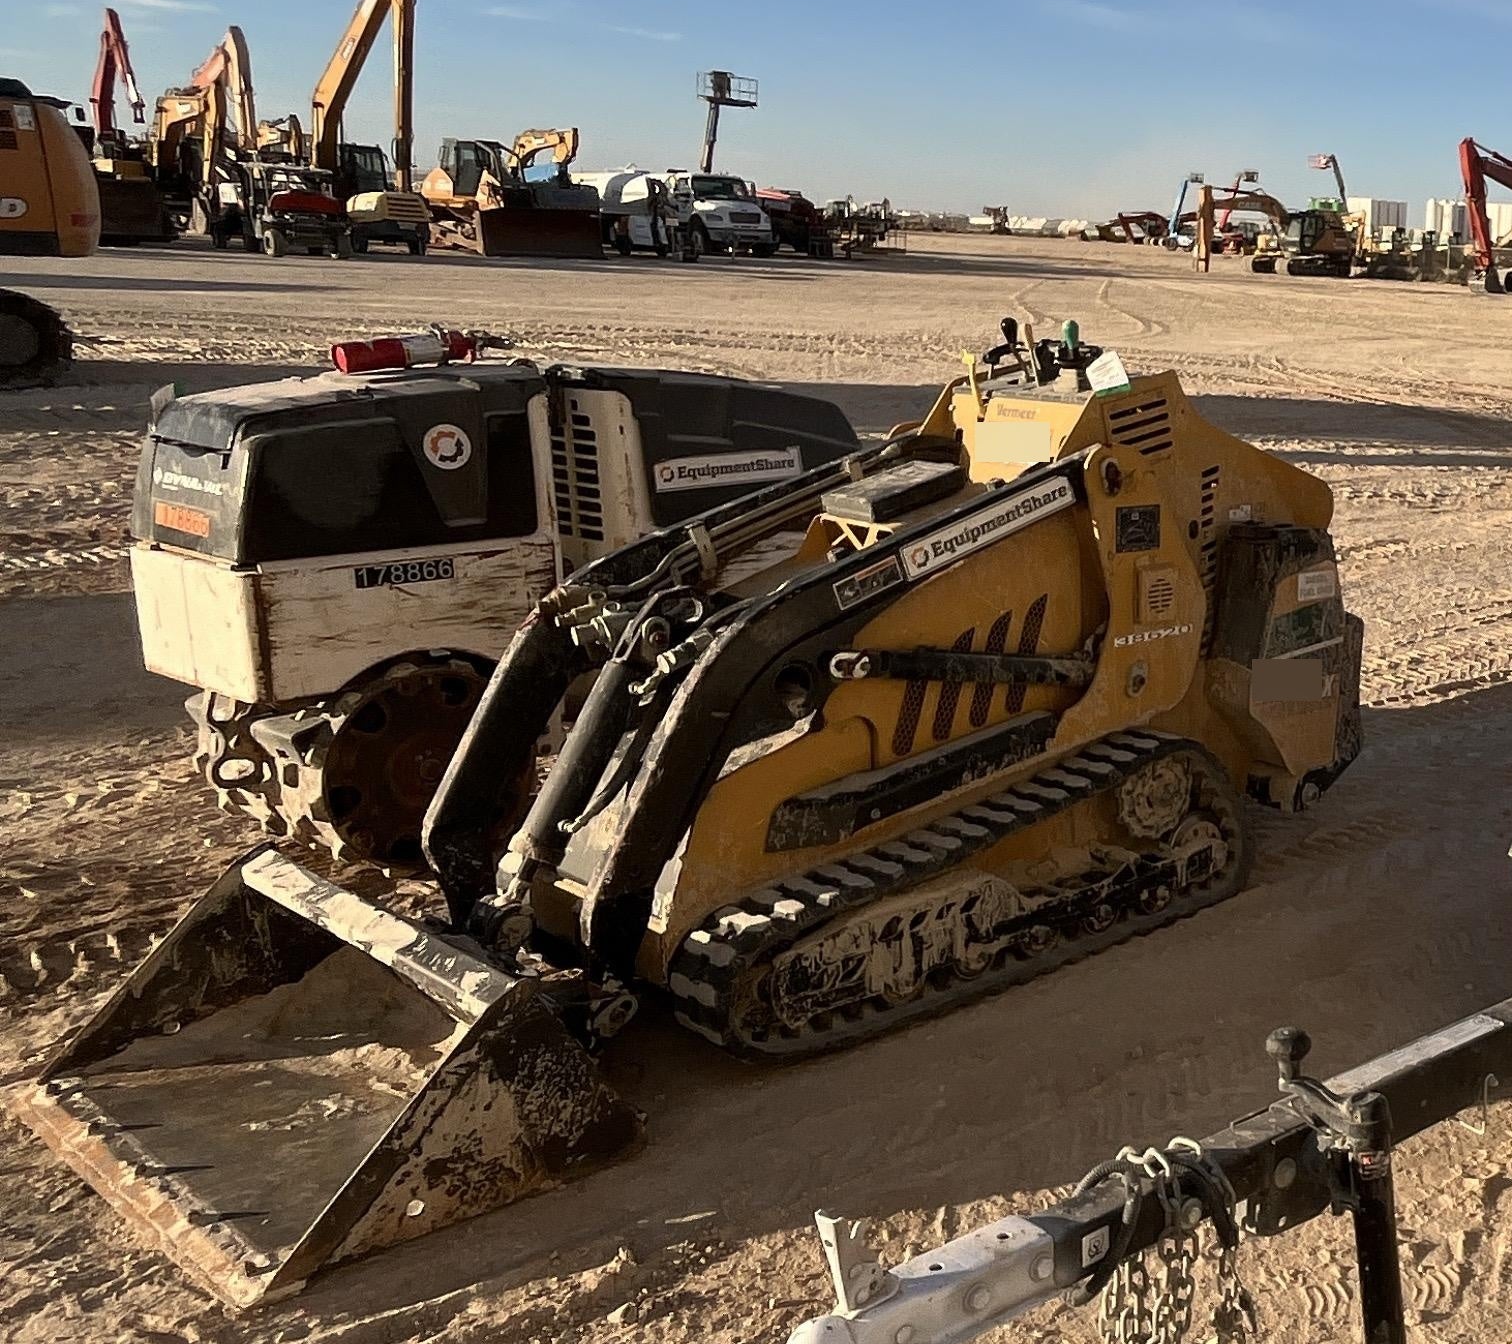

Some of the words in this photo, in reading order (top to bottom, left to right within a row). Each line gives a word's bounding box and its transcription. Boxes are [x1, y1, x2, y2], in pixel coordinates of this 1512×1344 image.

[996, 404, 1037, 419] Vermeer
[677, 458, 795, 481] EquipmentShare
[930, 485, 1068, 559] EquipmentShare
[358, 559, 453, 587] 178866
